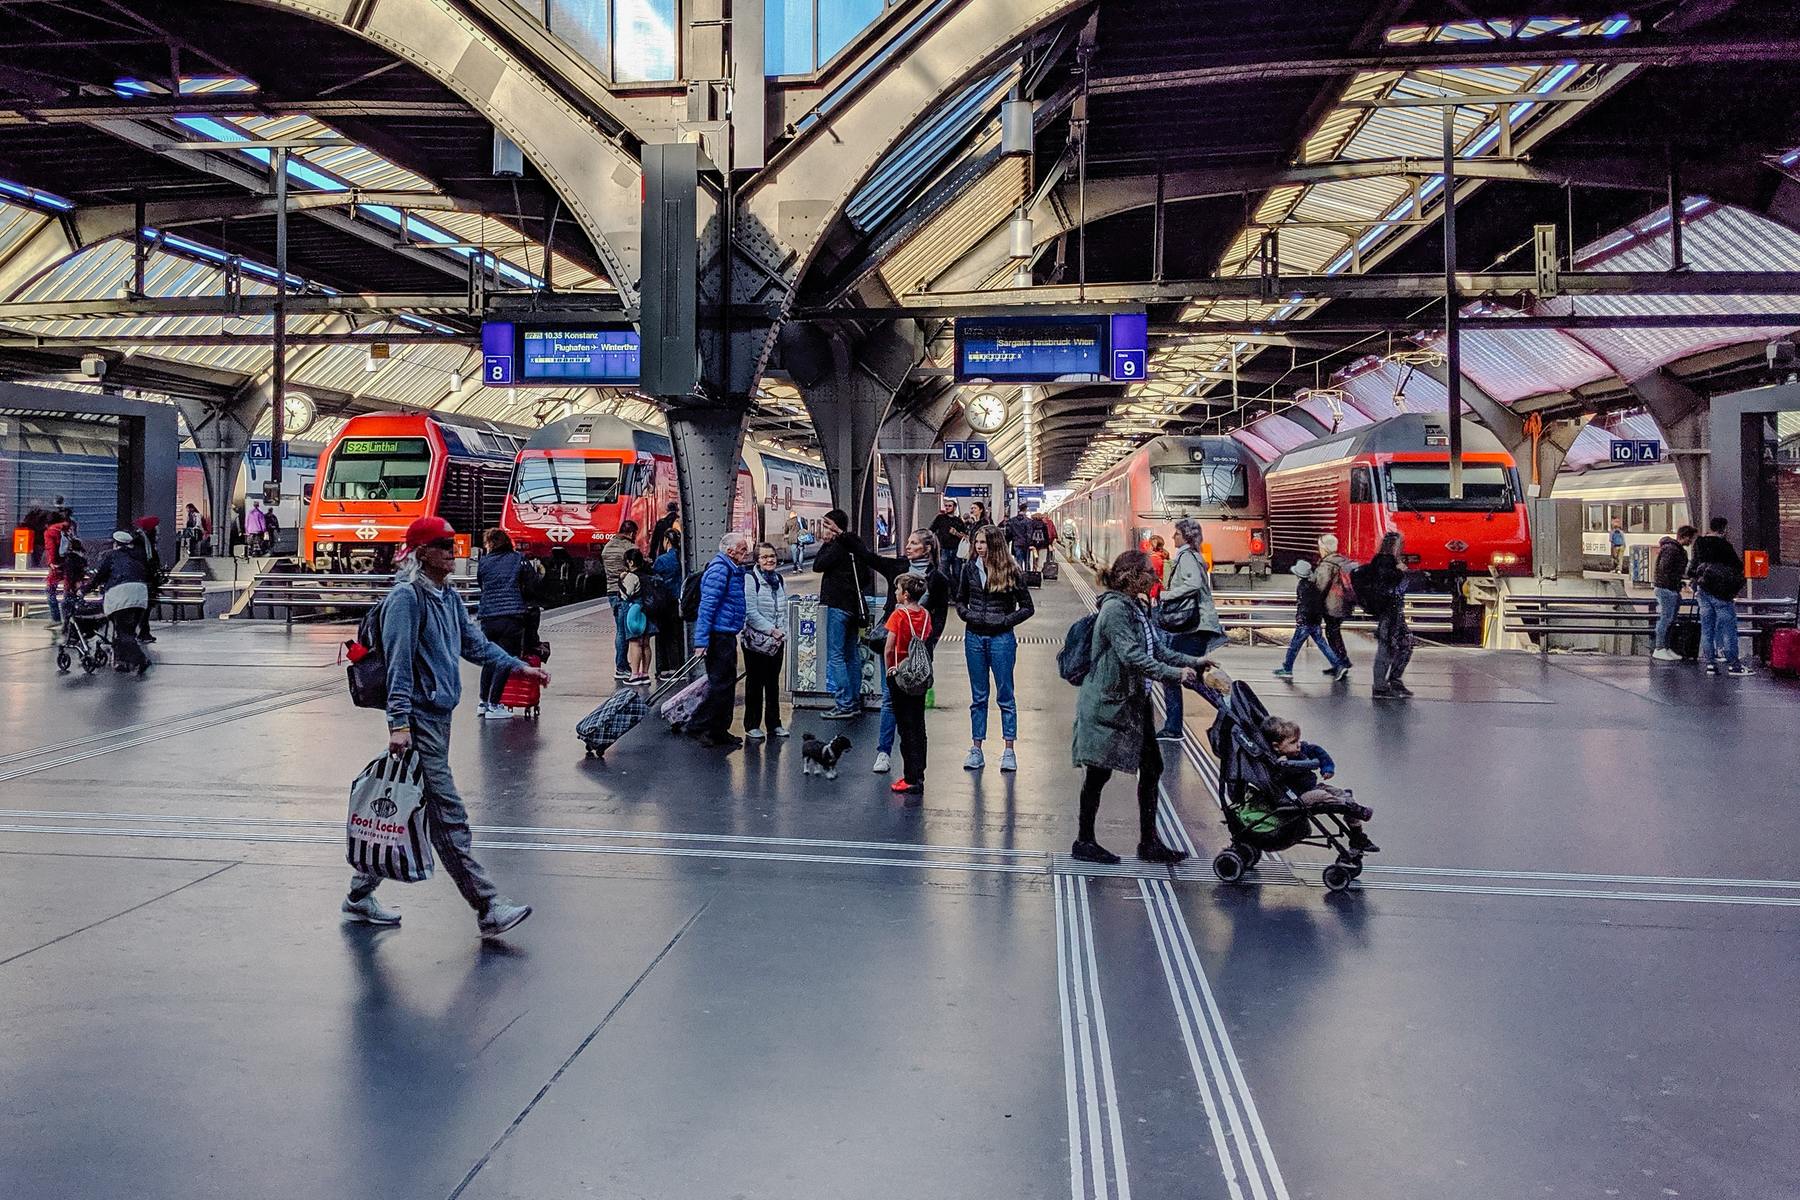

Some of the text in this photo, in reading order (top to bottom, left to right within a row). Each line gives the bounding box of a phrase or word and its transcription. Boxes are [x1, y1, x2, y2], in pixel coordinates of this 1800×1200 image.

[544, 332, 562, 340] 10.35
[564, 331, 599, 340] Konstanz
[555, 343, 639, 353] Flughafen Winterthur
[492, 366, 503, 381] 8
[1123, 360, 1136, 376] 9
[254, 446, 263, 457] A
[347, 441, 398, 452] S25 Linthal
[949, 448, 981, 459] A 9
[1615, 447, 1654, 459] 10 A
[351, 813, 373, 828] Foot
